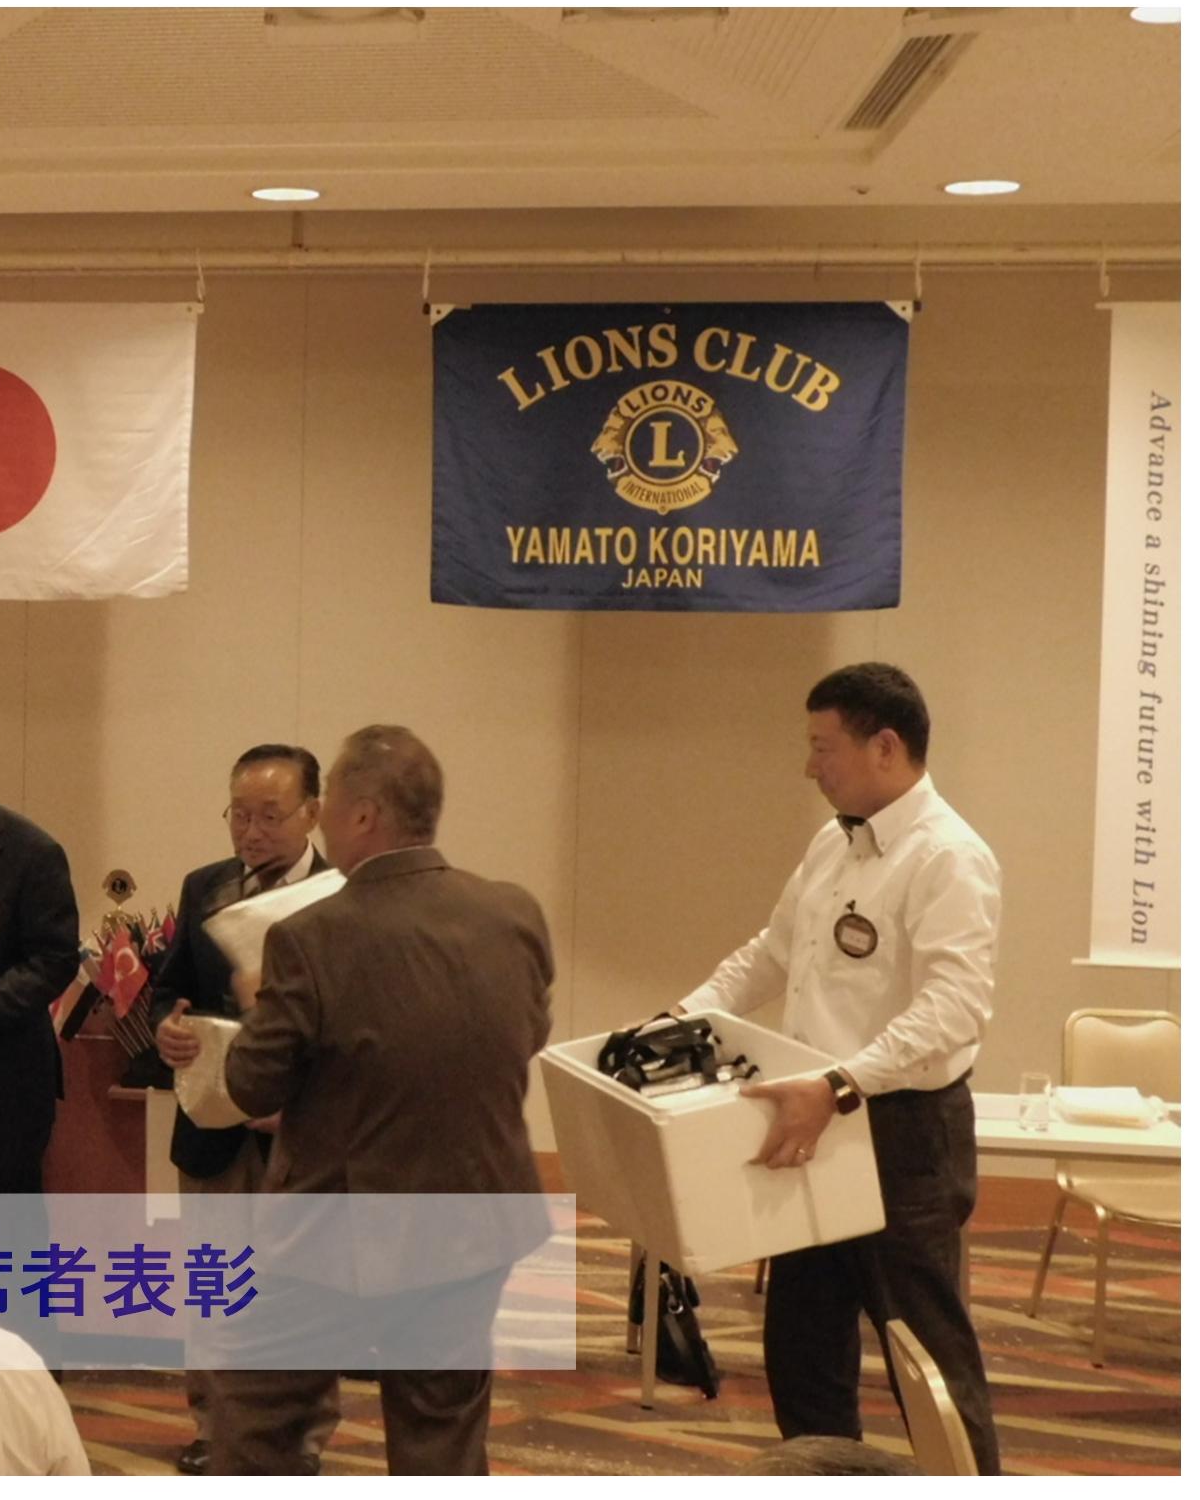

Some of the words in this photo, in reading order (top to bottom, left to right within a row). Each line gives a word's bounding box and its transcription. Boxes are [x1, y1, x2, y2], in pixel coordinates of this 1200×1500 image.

[498, 322, 678, 411] LIONS
[694, 326, 841, 412] CLUB
[624, 384, 708, 413] LIONS
[648, 421, 686, 467] L
[1146, 391, 1172, 522] Advance
[622, 480, 705, 505] INTERNATIONAL
[505, 526, 637, 566] YAMATO
[649, 527, 821, 568] KORIYAMA
[1145, 534, 1162, 549] a
[622, 568, 703, 589] JAPAN
[1137, 563, 1166, 678] shining
[1136, 690, 1162, 785] future
[1134, 799, 1157, 866] with
[1131, 878, 1155, 945] Lion
